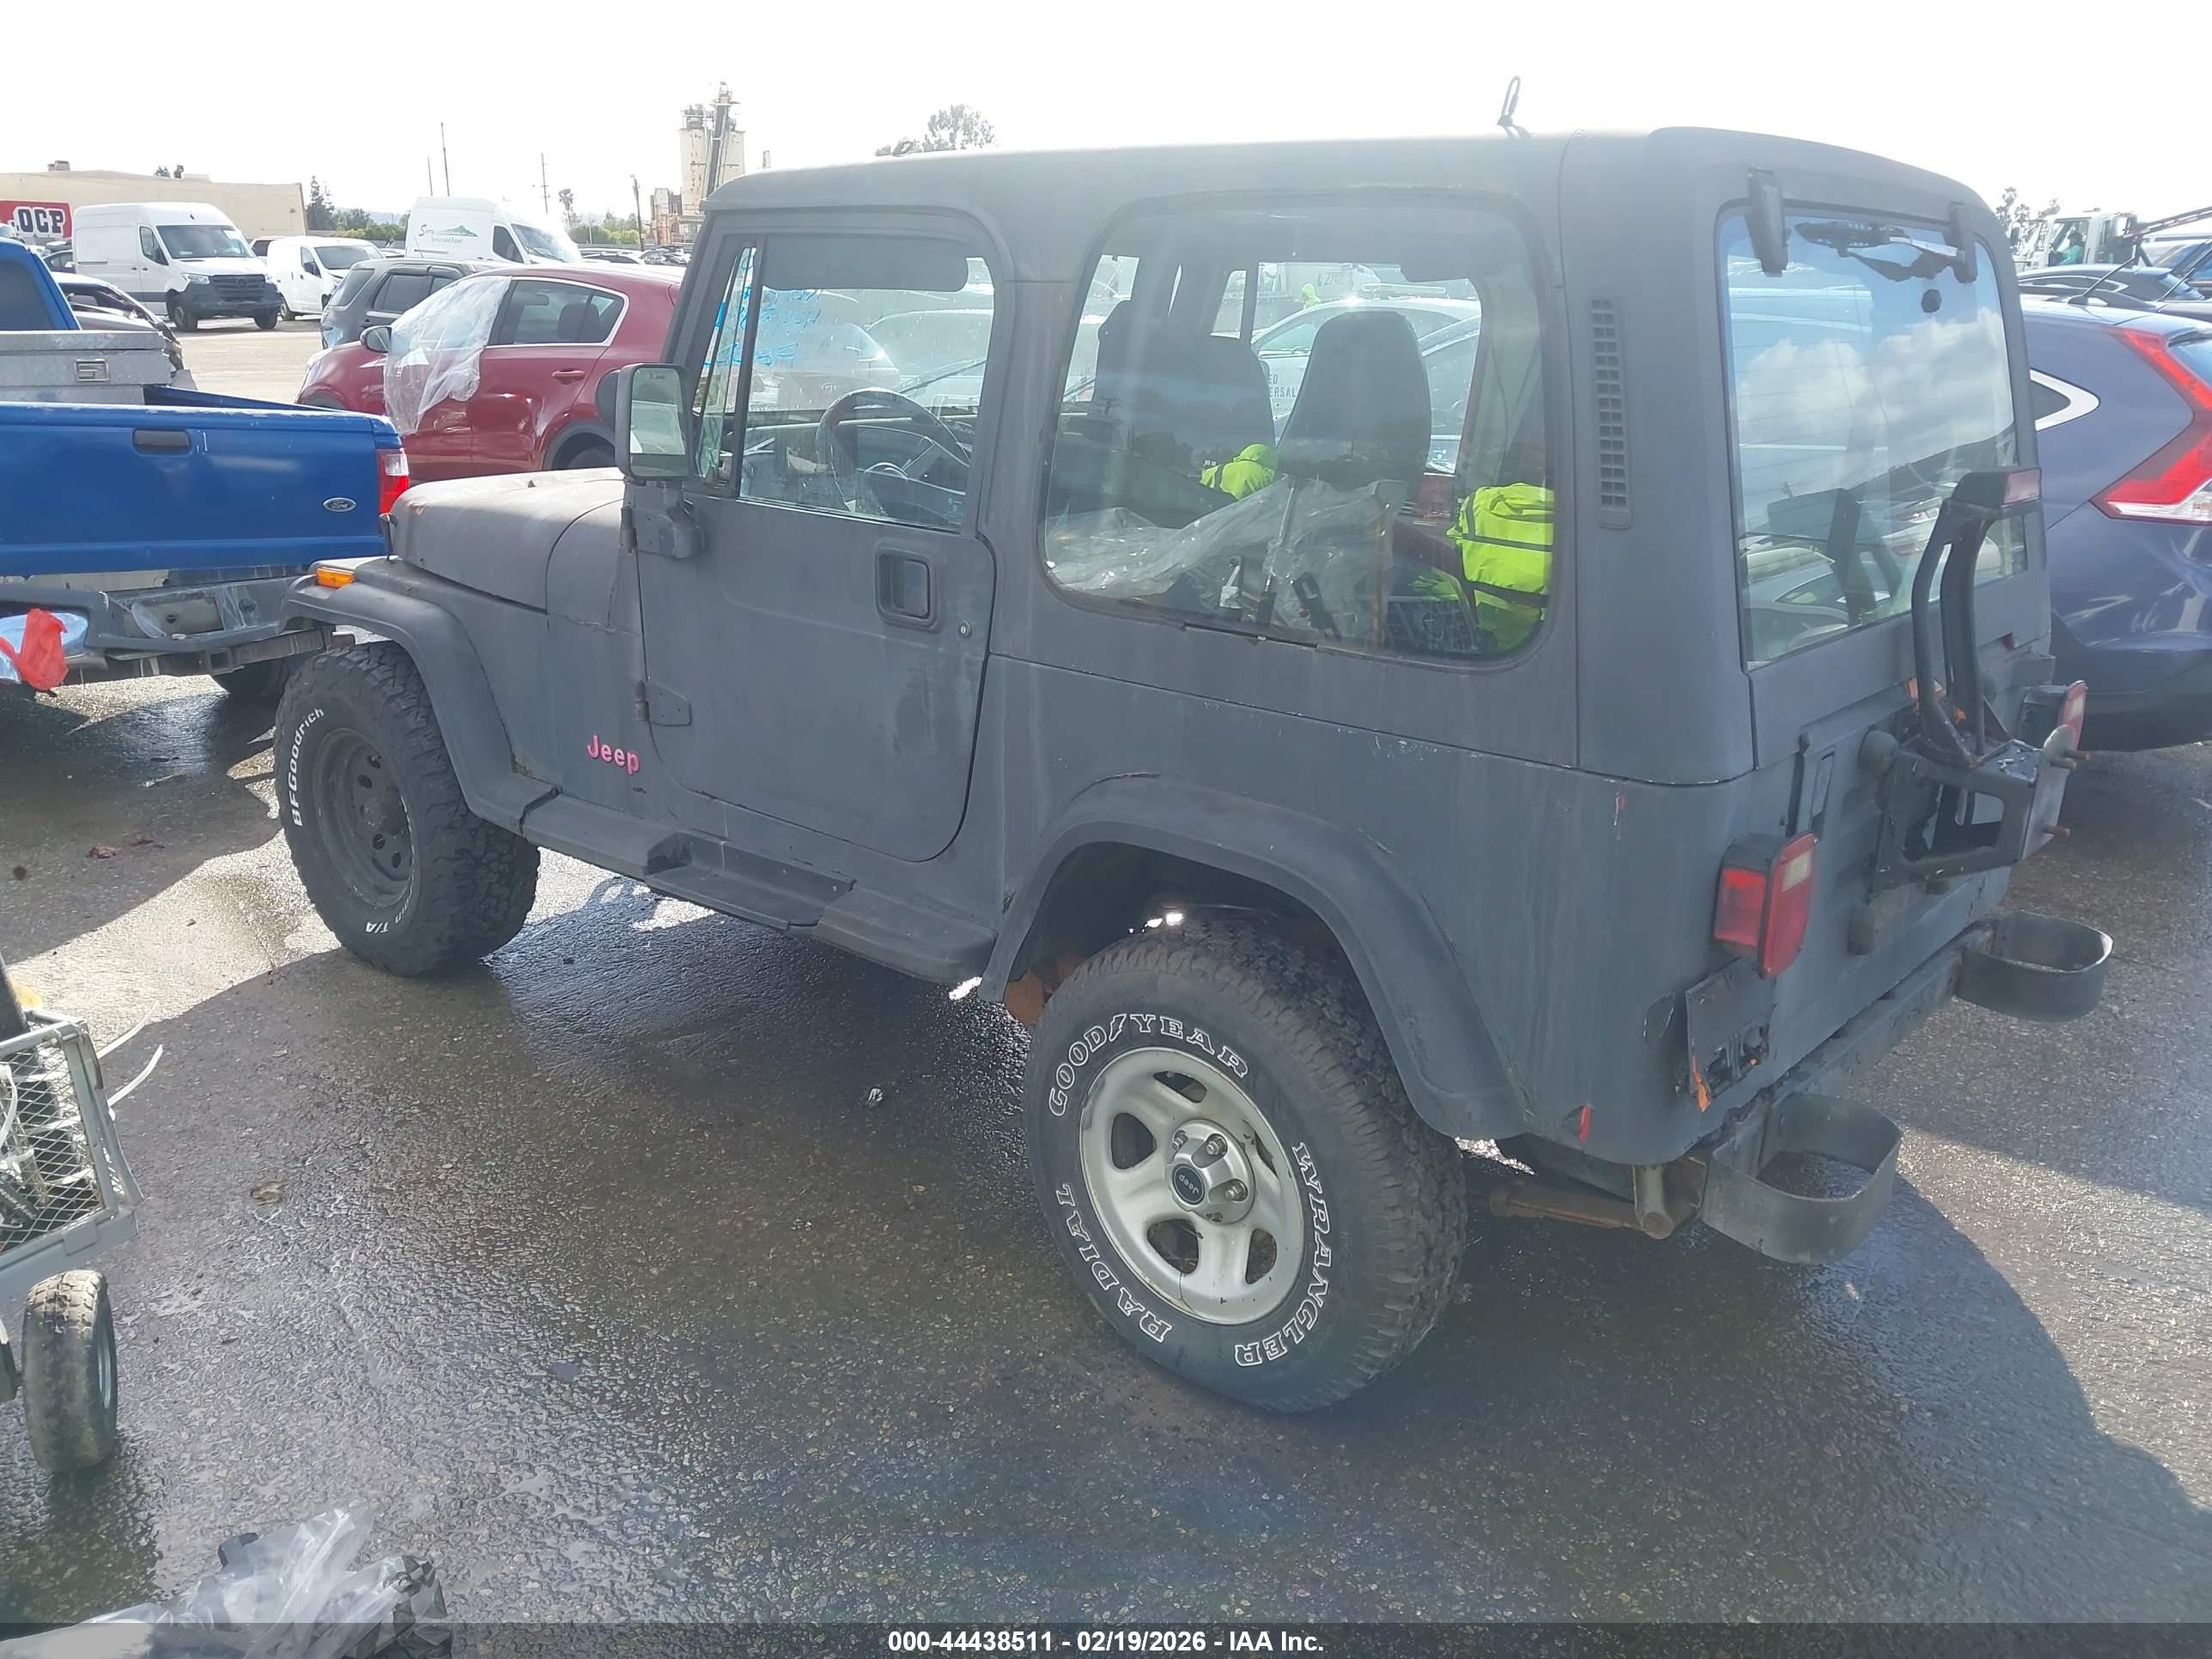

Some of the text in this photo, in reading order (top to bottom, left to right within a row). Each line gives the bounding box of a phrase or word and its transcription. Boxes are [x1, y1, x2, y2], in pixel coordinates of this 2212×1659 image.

[15, 207, 64, 235] OCP
[1270, 387, 1296, 398] ERSAL
[289, 708, 325, 827] BFGoodrich
[586, 734, 640, 775] Jeep
[365, 921, 389, 934] T/A
[1178, 1174, 1200, 1194] Jeep
[1055, 1183, 1173, 1342] RADIAL
[1235, 1142, 1332, 1367] WRANGLER
